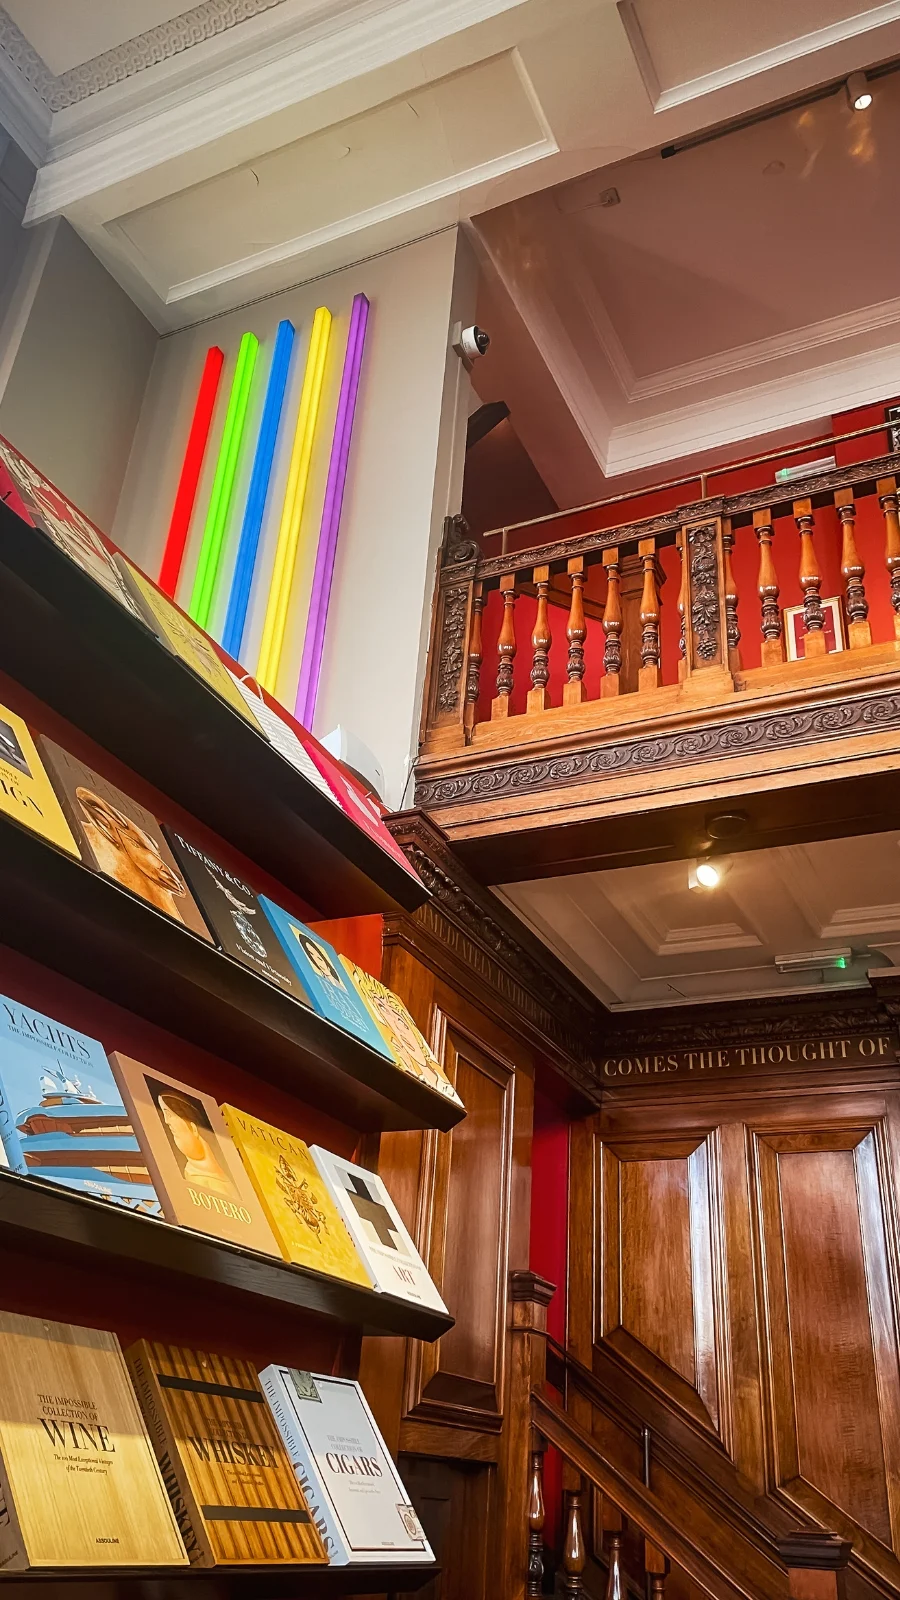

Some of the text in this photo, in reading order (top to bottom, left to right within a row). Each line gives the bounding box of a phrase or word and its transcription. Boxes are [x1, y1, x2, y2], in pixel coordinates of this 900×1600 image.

[174, 833, 224, 877] TIFFANY
[3, 1003, 91, 1060] YACHTS
[604, 1054, 679, 1076] COMES
[684, 1049, 730, 1070] THE
[735, 1040, 851, 1065] THOUGHT
[858, 1036, 891, 1057] OF
[236, 1117, 309, 1160] VATICAN
[187, 1187, 252, 1225] BOTERO
[37, 1394, 98, 1410] THE IMPOSSIBLE
[42, 1406, 88, 1420] COLLECTION
[37, 1417, 116, 1452] WINE
[187, 1435, 279, 1468] WHISKEY
[326, 1452, 383, 1477] CIGARS
[159, 1451, 202, 1554] WHISKEY
